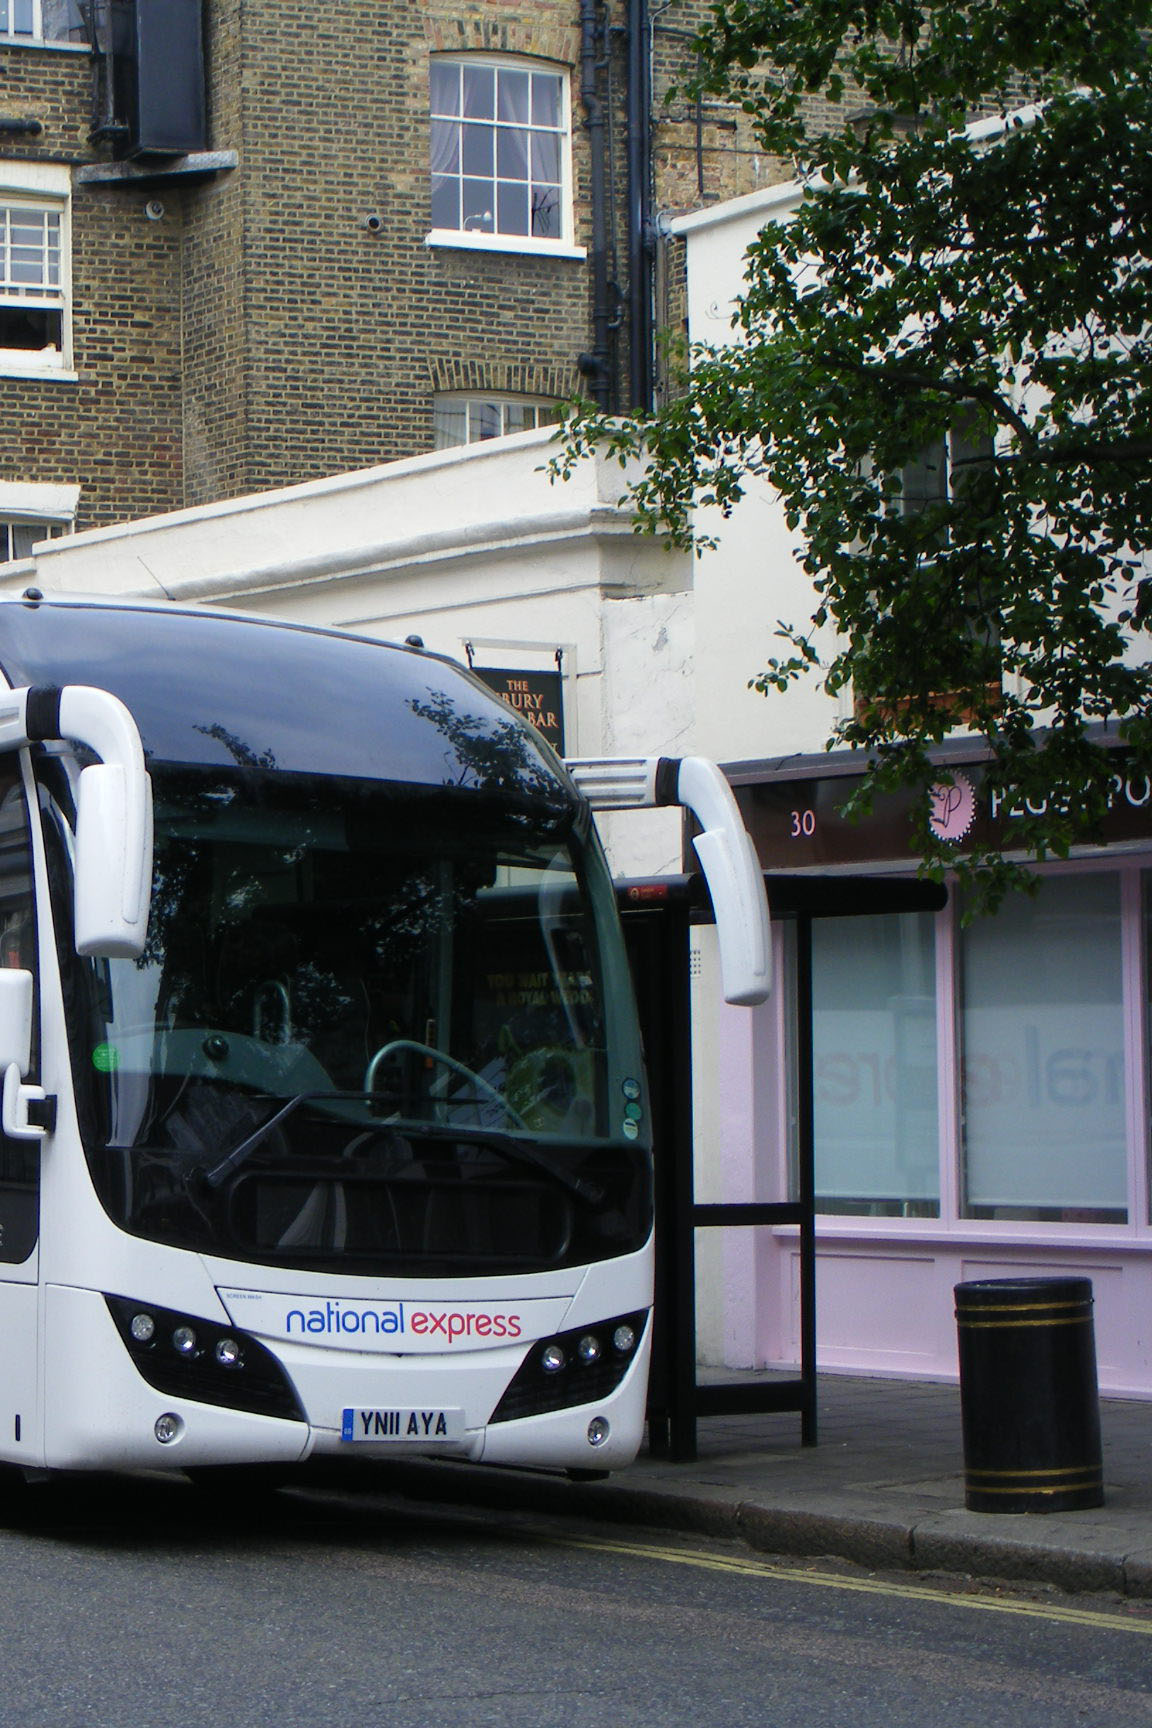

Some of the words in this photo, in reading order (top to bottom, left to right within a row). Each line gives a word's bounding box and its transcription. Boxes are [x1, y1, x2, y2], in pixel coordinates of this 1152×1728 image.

[507, 680, 529, 692] THE
[496, 692, 544, 711] BURY
[527, 711, 559, 729] BAR
[790, 809, 817, 838] 30
[286, 1301, 405, 1334] national
[411, 1311, 522, 1344] express
[361, 1411, 400, 1435] YN11
[407, 1411, 447, 1435] AYA
